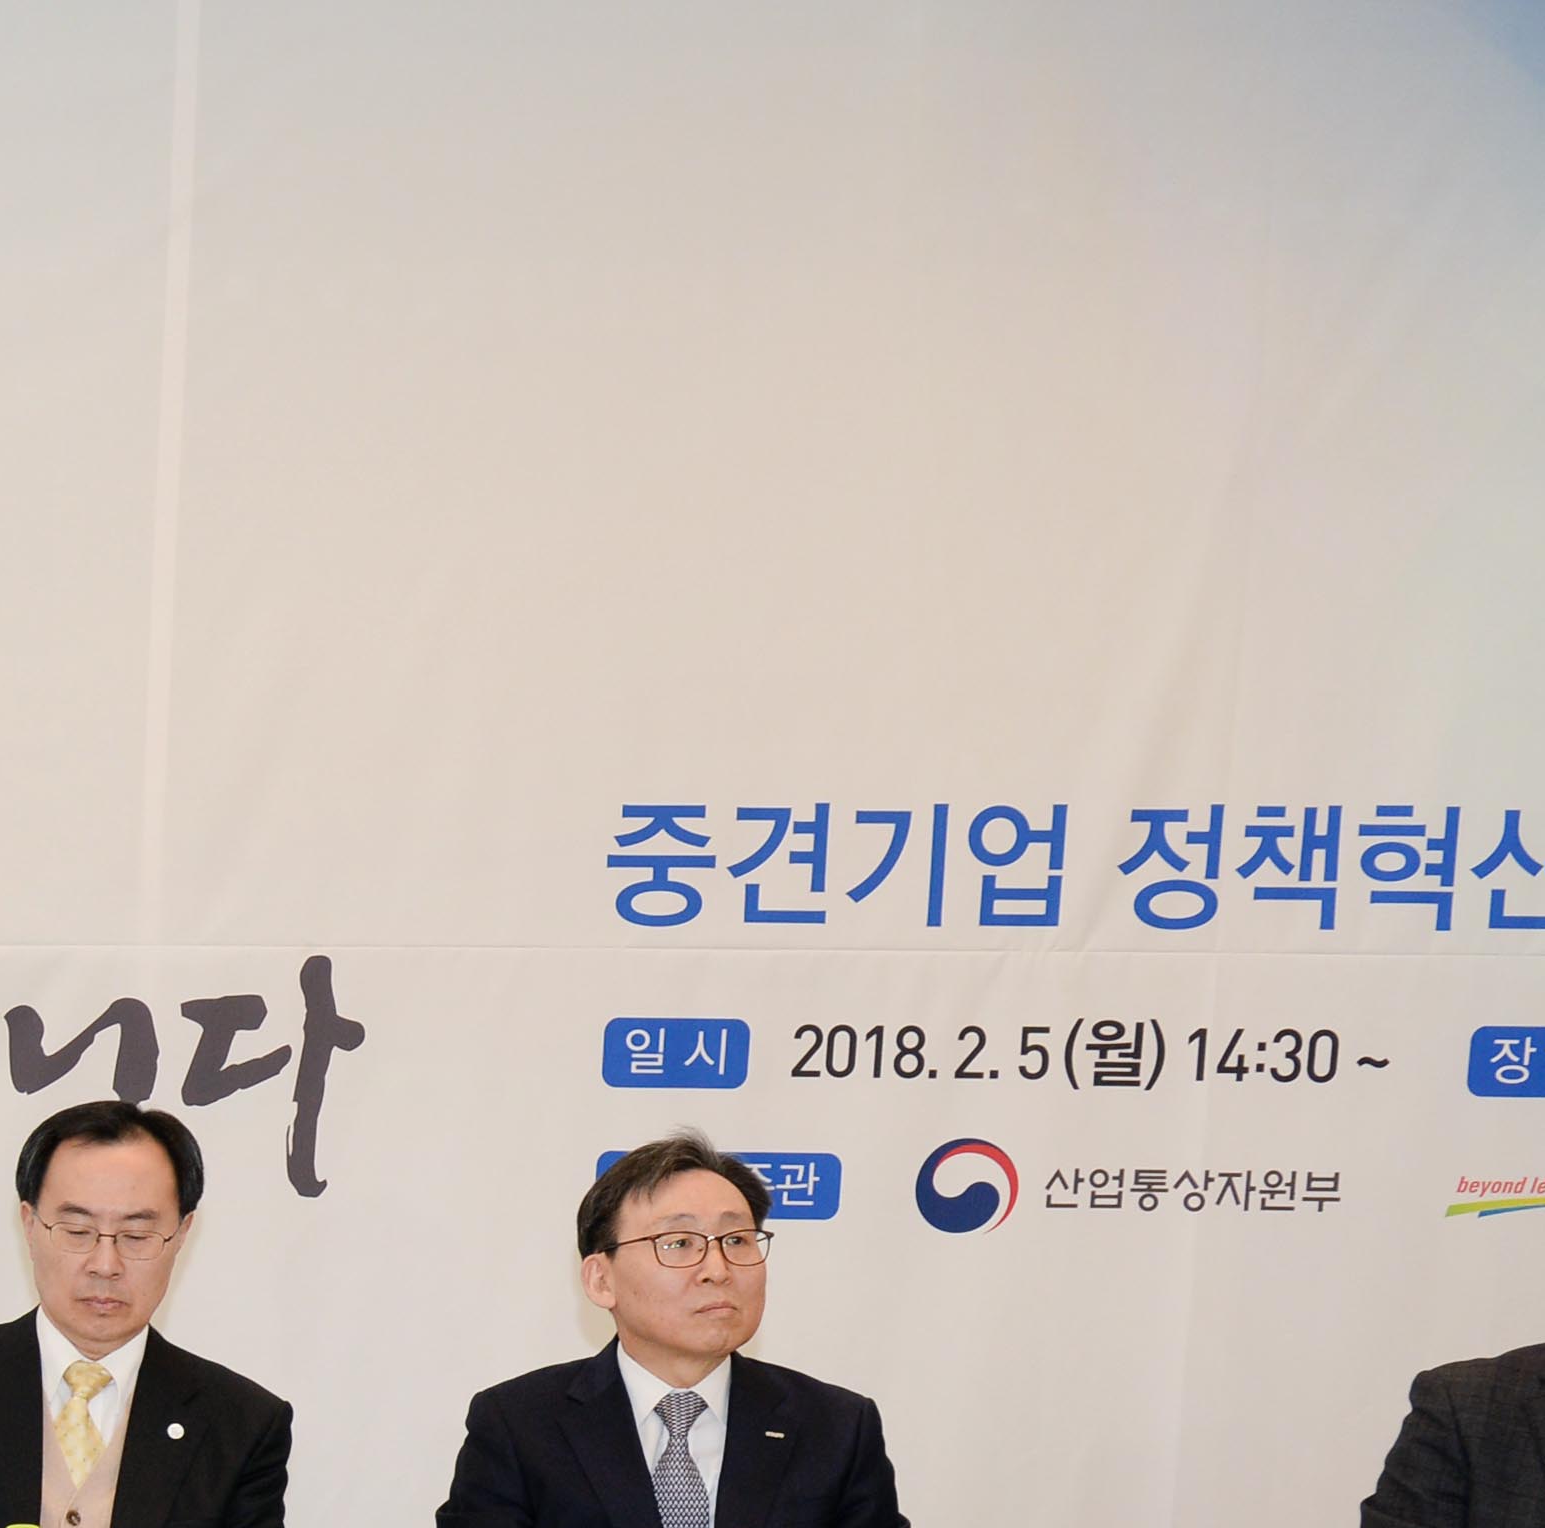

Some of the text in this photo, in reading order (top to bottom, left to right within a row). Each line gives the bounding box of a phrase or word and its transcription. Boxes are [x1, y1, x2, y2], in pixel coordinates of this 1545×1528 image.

[608, 803, 1067, 926] 중견기업
[1045, 1167, 1341, 1213] 산업통상자원부
[1456, 1175, 1528, 1198] beyond
